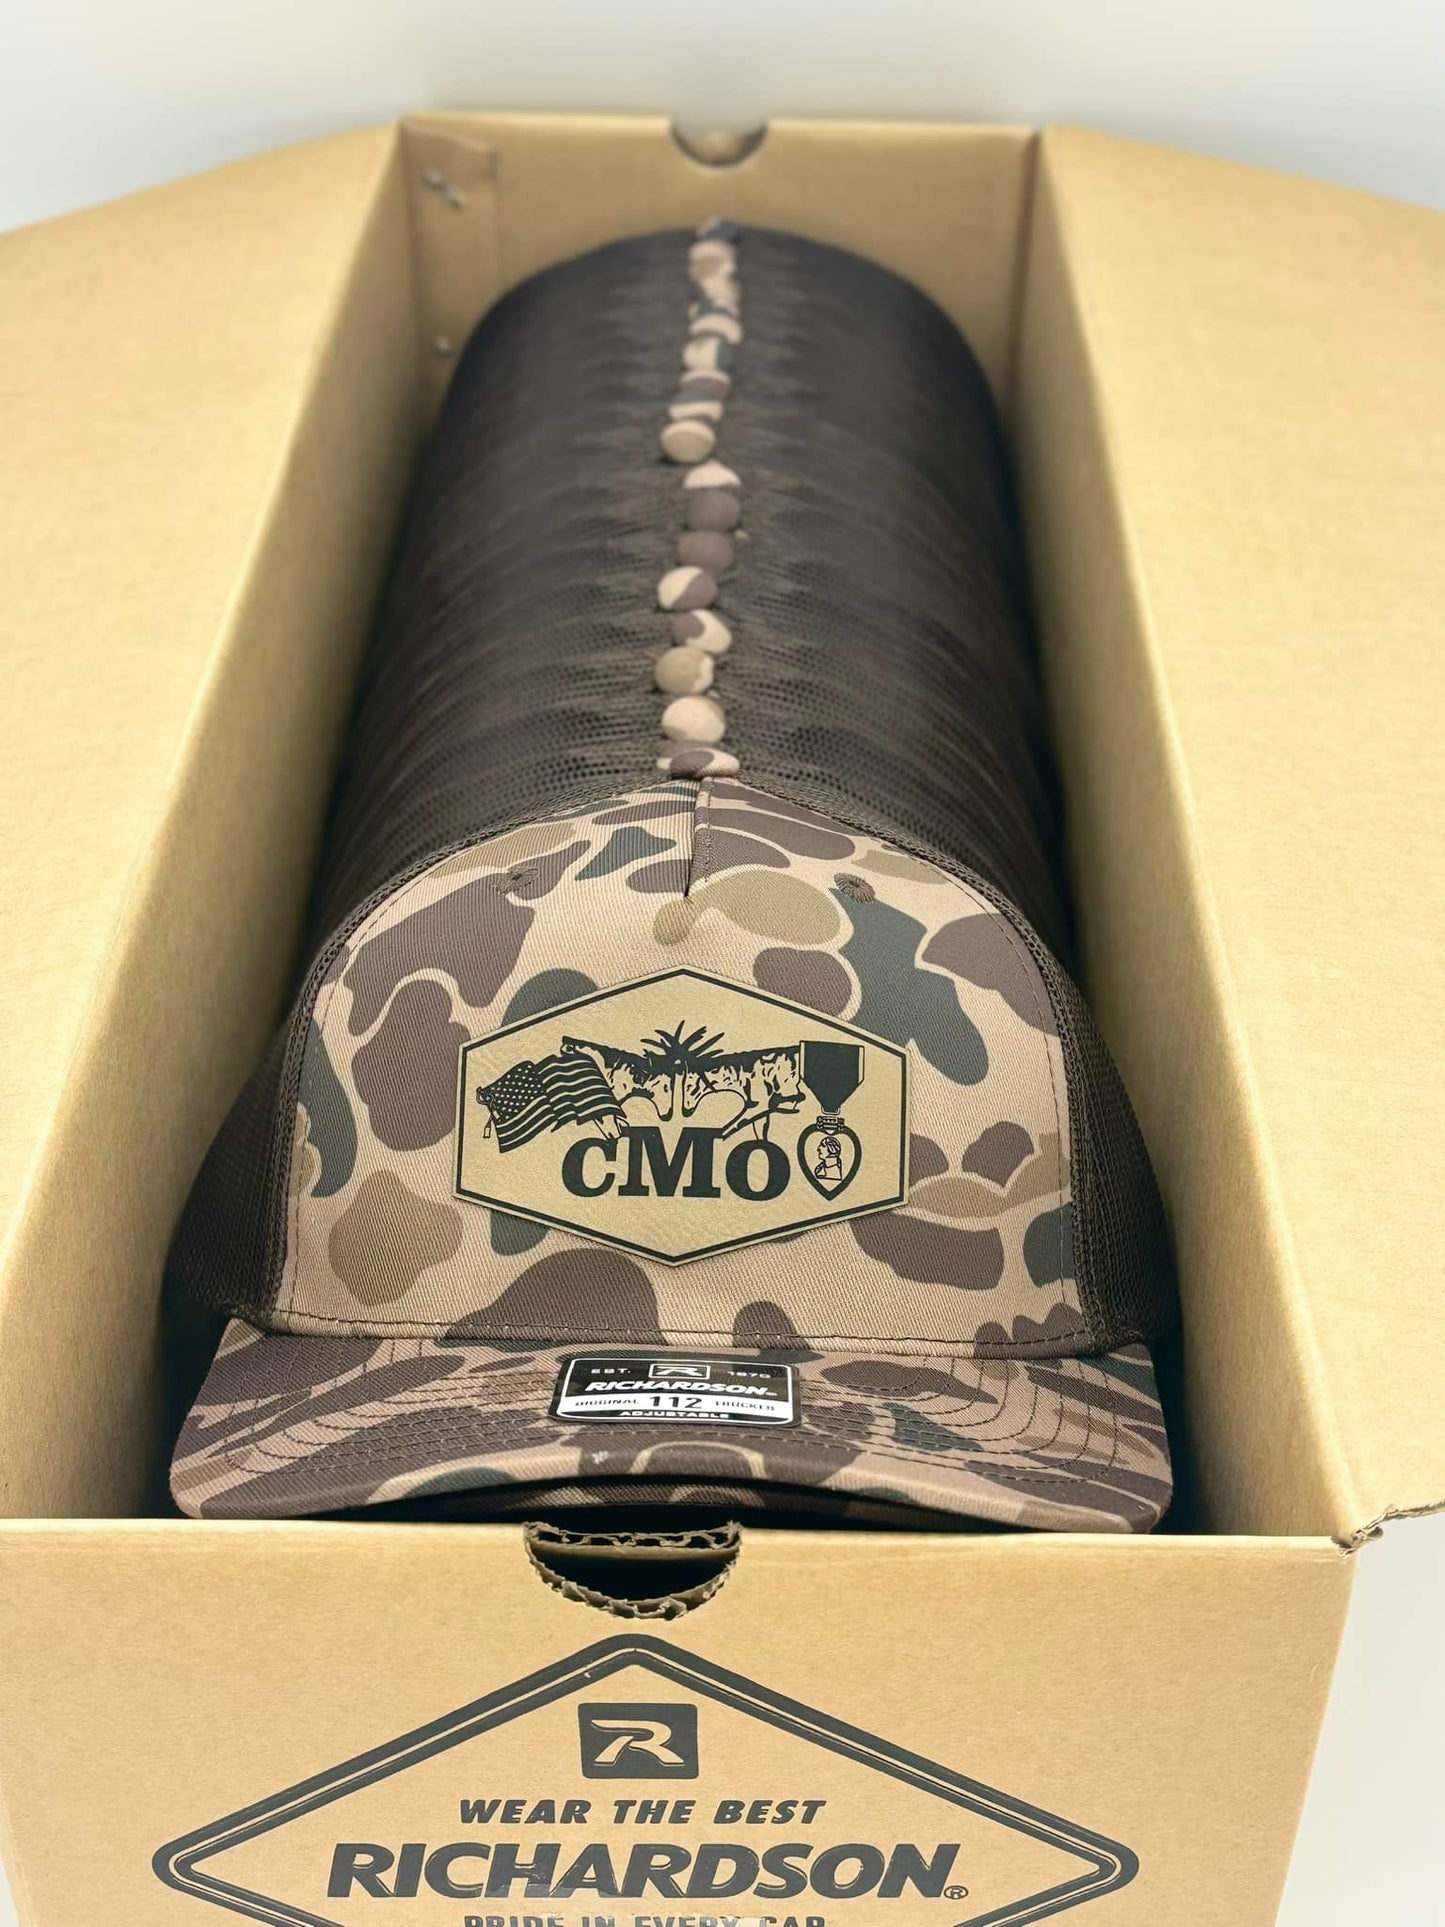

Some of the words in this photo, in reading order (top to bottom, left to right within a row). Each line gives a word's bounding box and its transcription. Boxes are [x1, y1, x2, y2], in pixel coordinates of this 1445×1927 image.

[561, 1126, 791, 1201] CMO
[649, 1395, 703, 1409] 112
[619, 1410, 730, 1419] ADJUSTABLE
[459, 1799, 592, 1824] WEAR
[612, 1799, 697, 1824] THE
[712, 1799, 827, 1825] BEST
